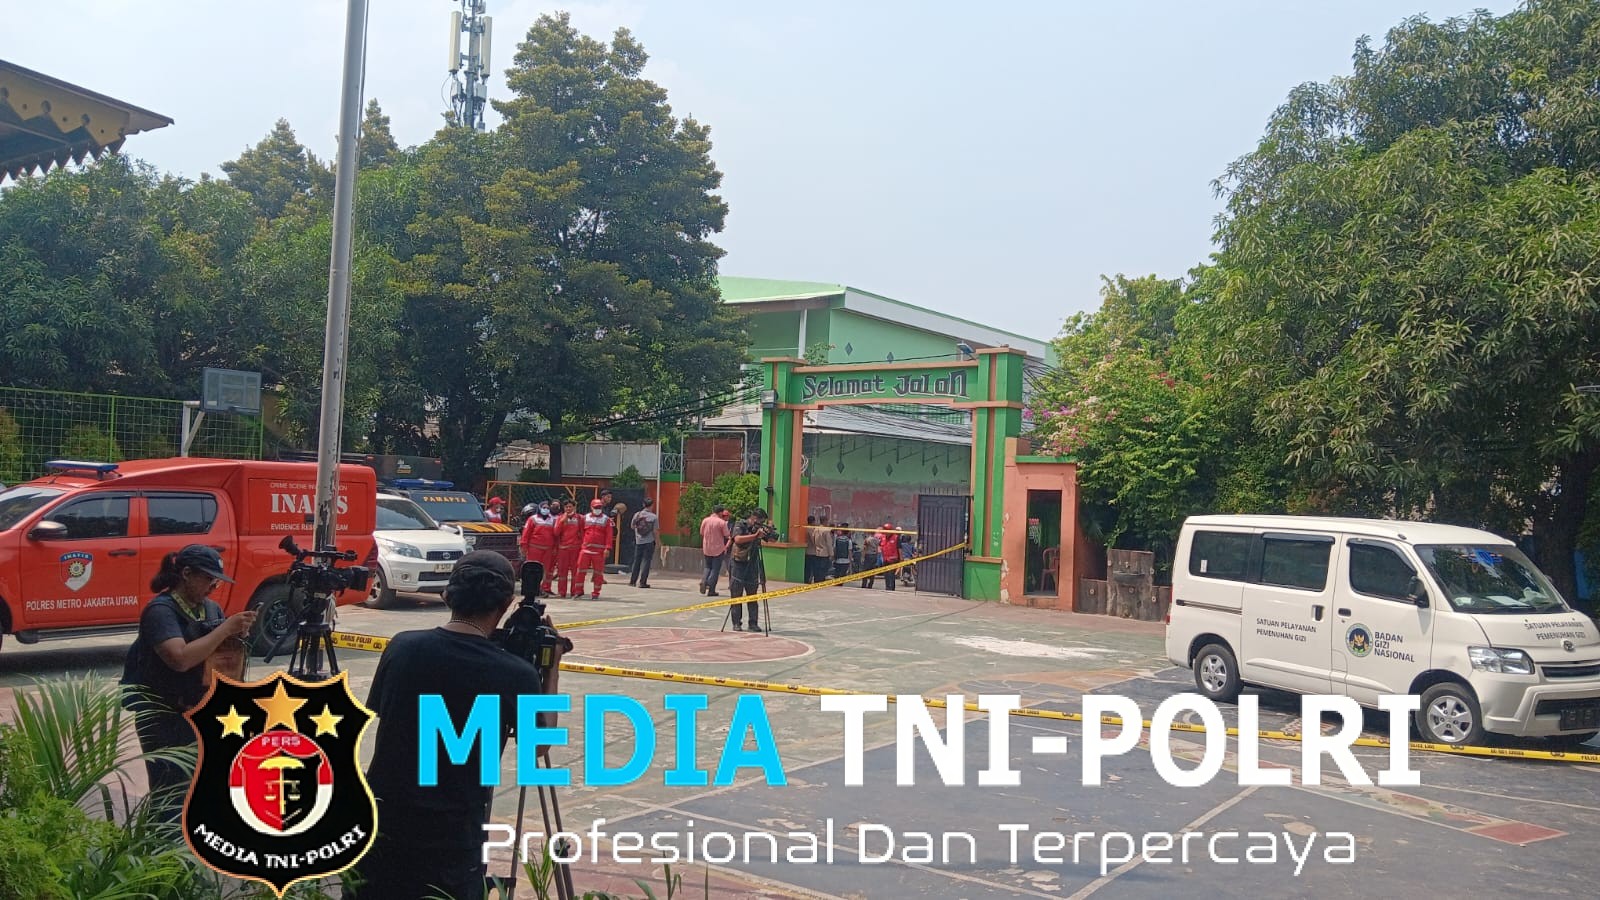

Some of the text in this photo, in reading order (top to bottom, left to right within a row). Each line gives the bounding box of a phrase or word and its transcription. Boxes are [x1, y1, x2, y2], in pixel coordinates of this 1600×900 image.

[801, 375, 885, 402] Selamat
[271, 493, 349, 515] INAS
[271, 523, 300, 531] EVIDENCE
[26, 596, 138, 611] POLRES METRO JAKARTA UTARA
[1257, 618, 1316, 633] SATUAN PELAYANAN
[1257, 628, 1306, 642] PEMENUHAN GIZI
[1374, 631, 1403, 643] BADAN
[1374, 640, 1390, 649] GIZI
[1374, 648, 1415, 663] NASIONAL
